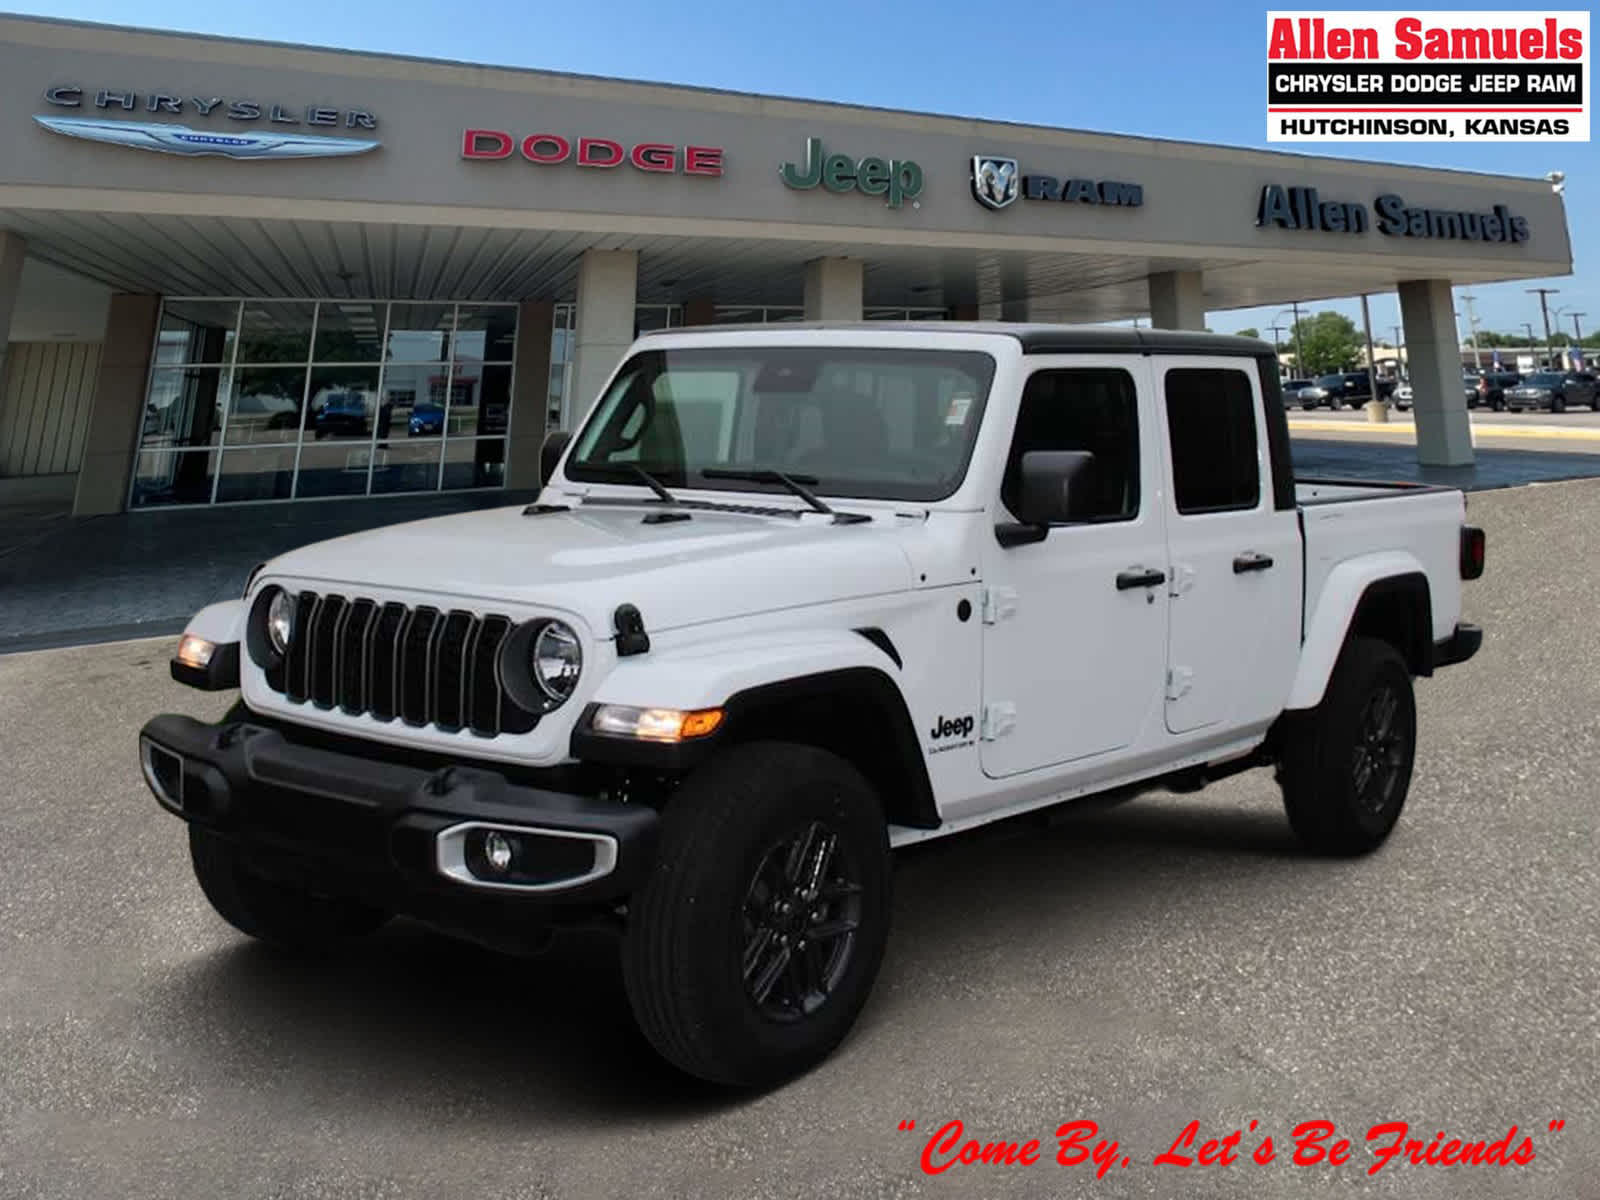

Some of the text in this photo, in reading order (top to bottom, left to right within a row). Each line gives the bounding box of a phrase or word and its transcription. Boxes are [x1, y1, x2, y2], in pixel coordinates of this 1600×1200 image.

[43, 84, 378, 129] CHRYSLER
[461, 128, 724, 176] DODGE
[779, 136, 924, 209] Jeep
[1021, 174, 1144, 208] RAM
[1255, 182, 1530, 244] Allen Samuels
[930, 714, 974, 740] Jeep
